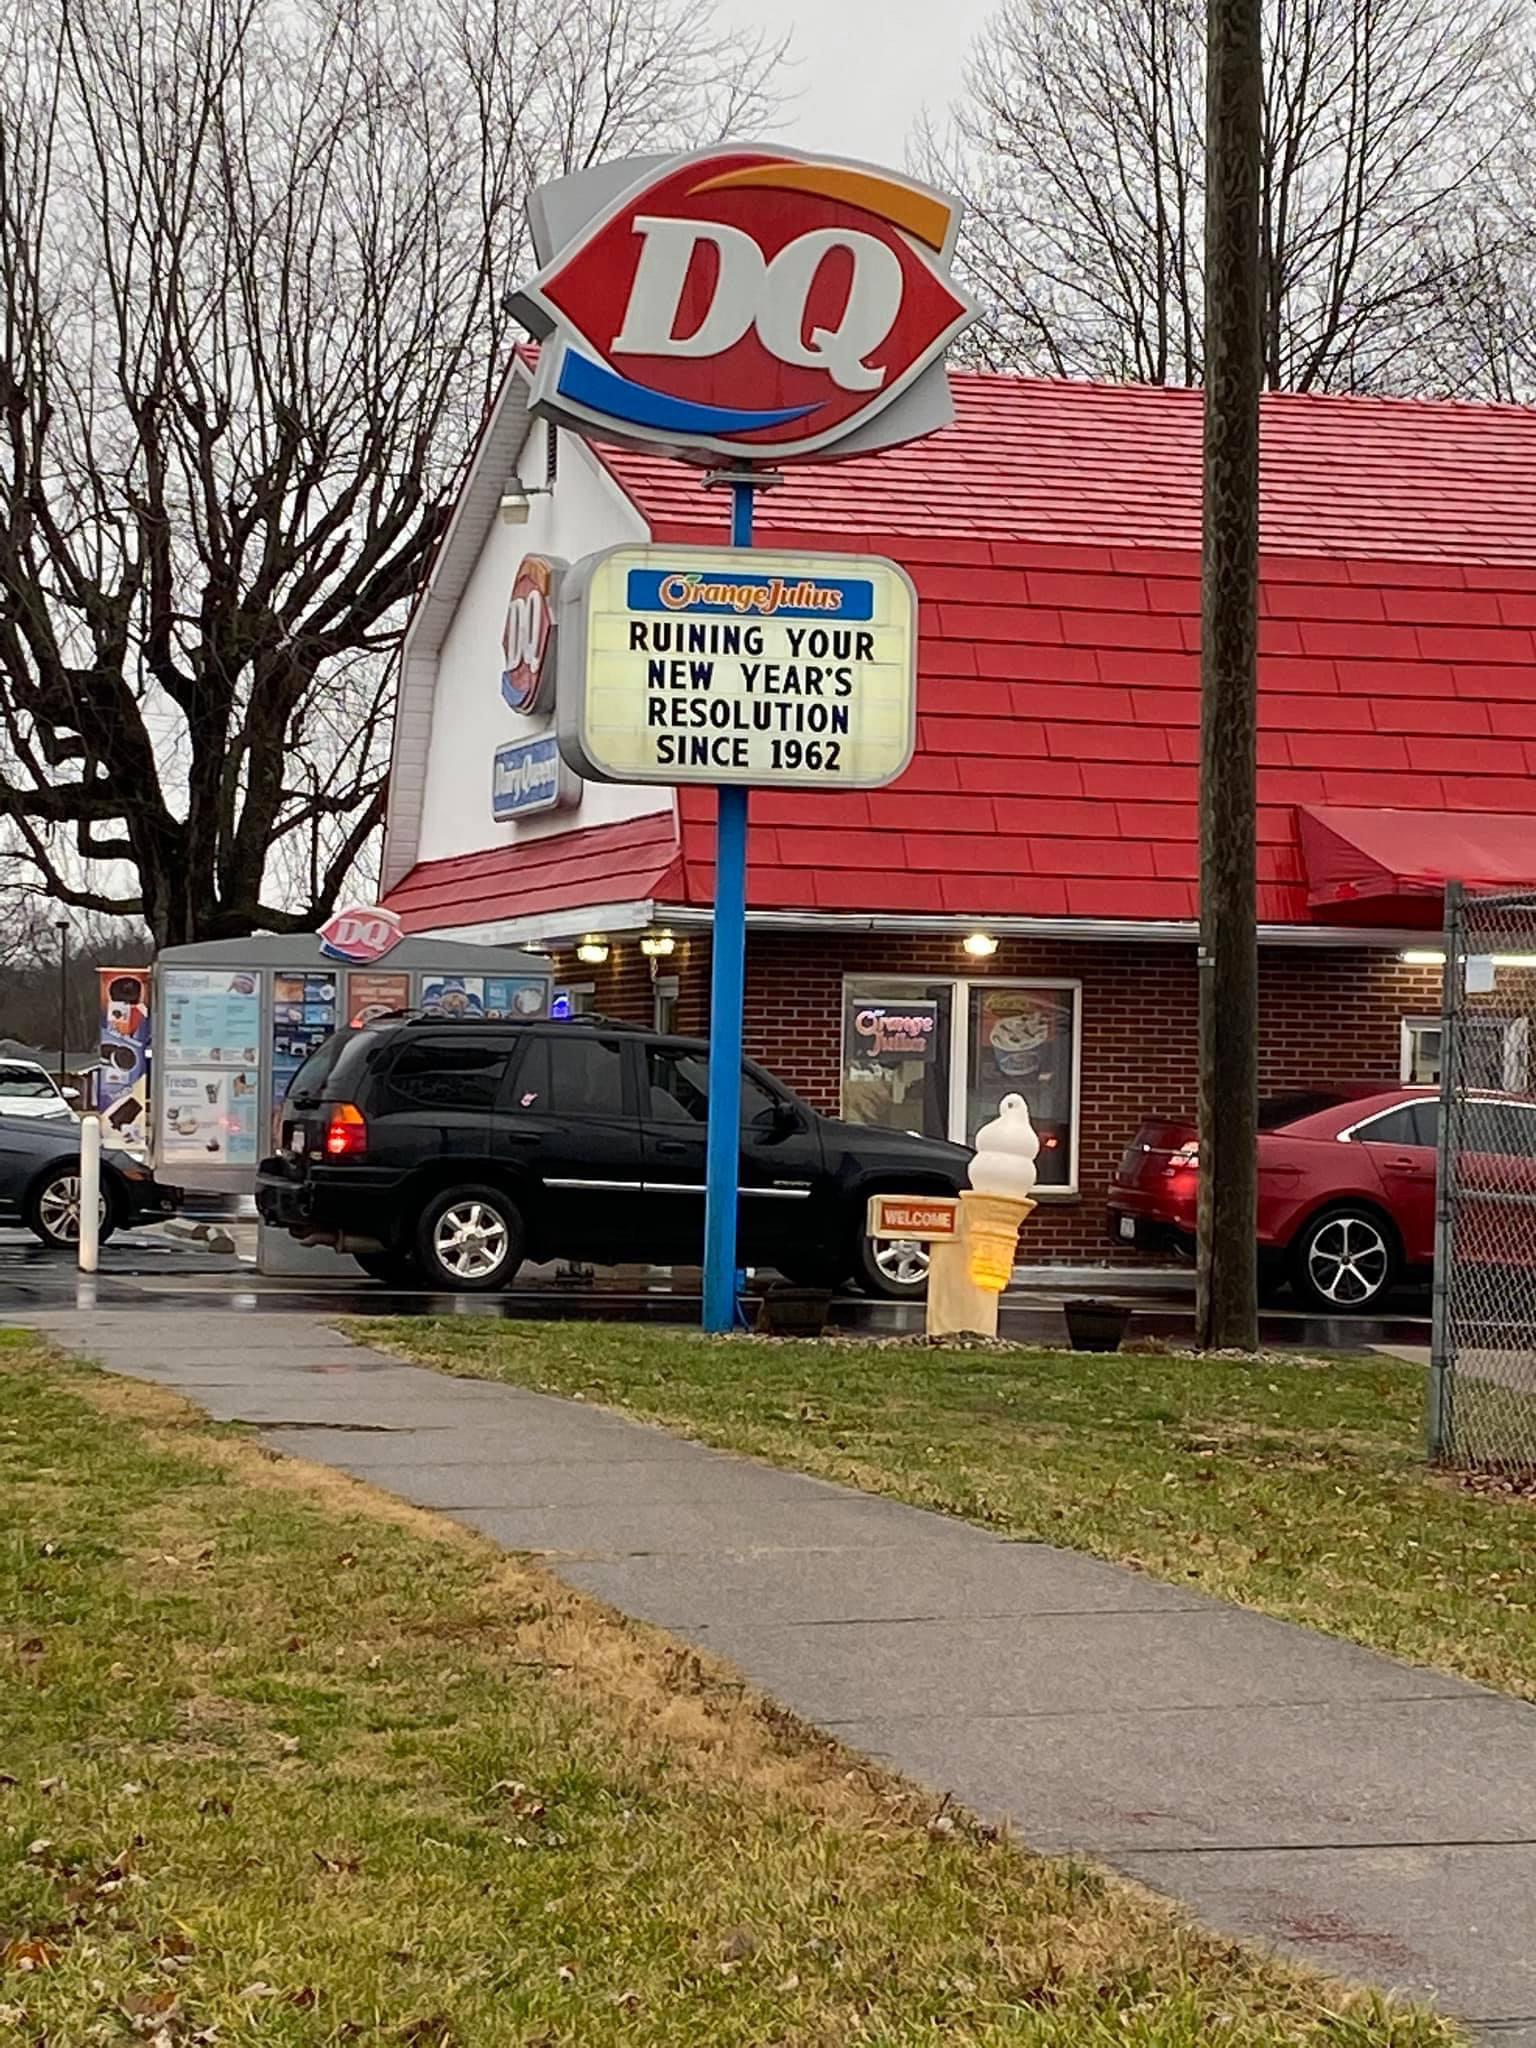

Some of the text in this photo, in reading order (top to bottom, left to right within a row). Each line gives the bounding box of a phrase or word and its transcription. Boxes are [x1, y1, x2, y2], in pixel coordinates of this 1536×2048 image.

[609, 215, 904, 392] DQ
[629, 621, 875, 661] RUINING YOUR
[648, 659, 852, 697] NEW YEAR'S
[648, 697, 849, 734] RESOLUTION
[656, 734, 841, 770] SINCE 1962
[334, 918, 391, 951] DQ
[856, 1010, 934, 1036] Orange
[884, 1209, 951, 1229] WELCOME
